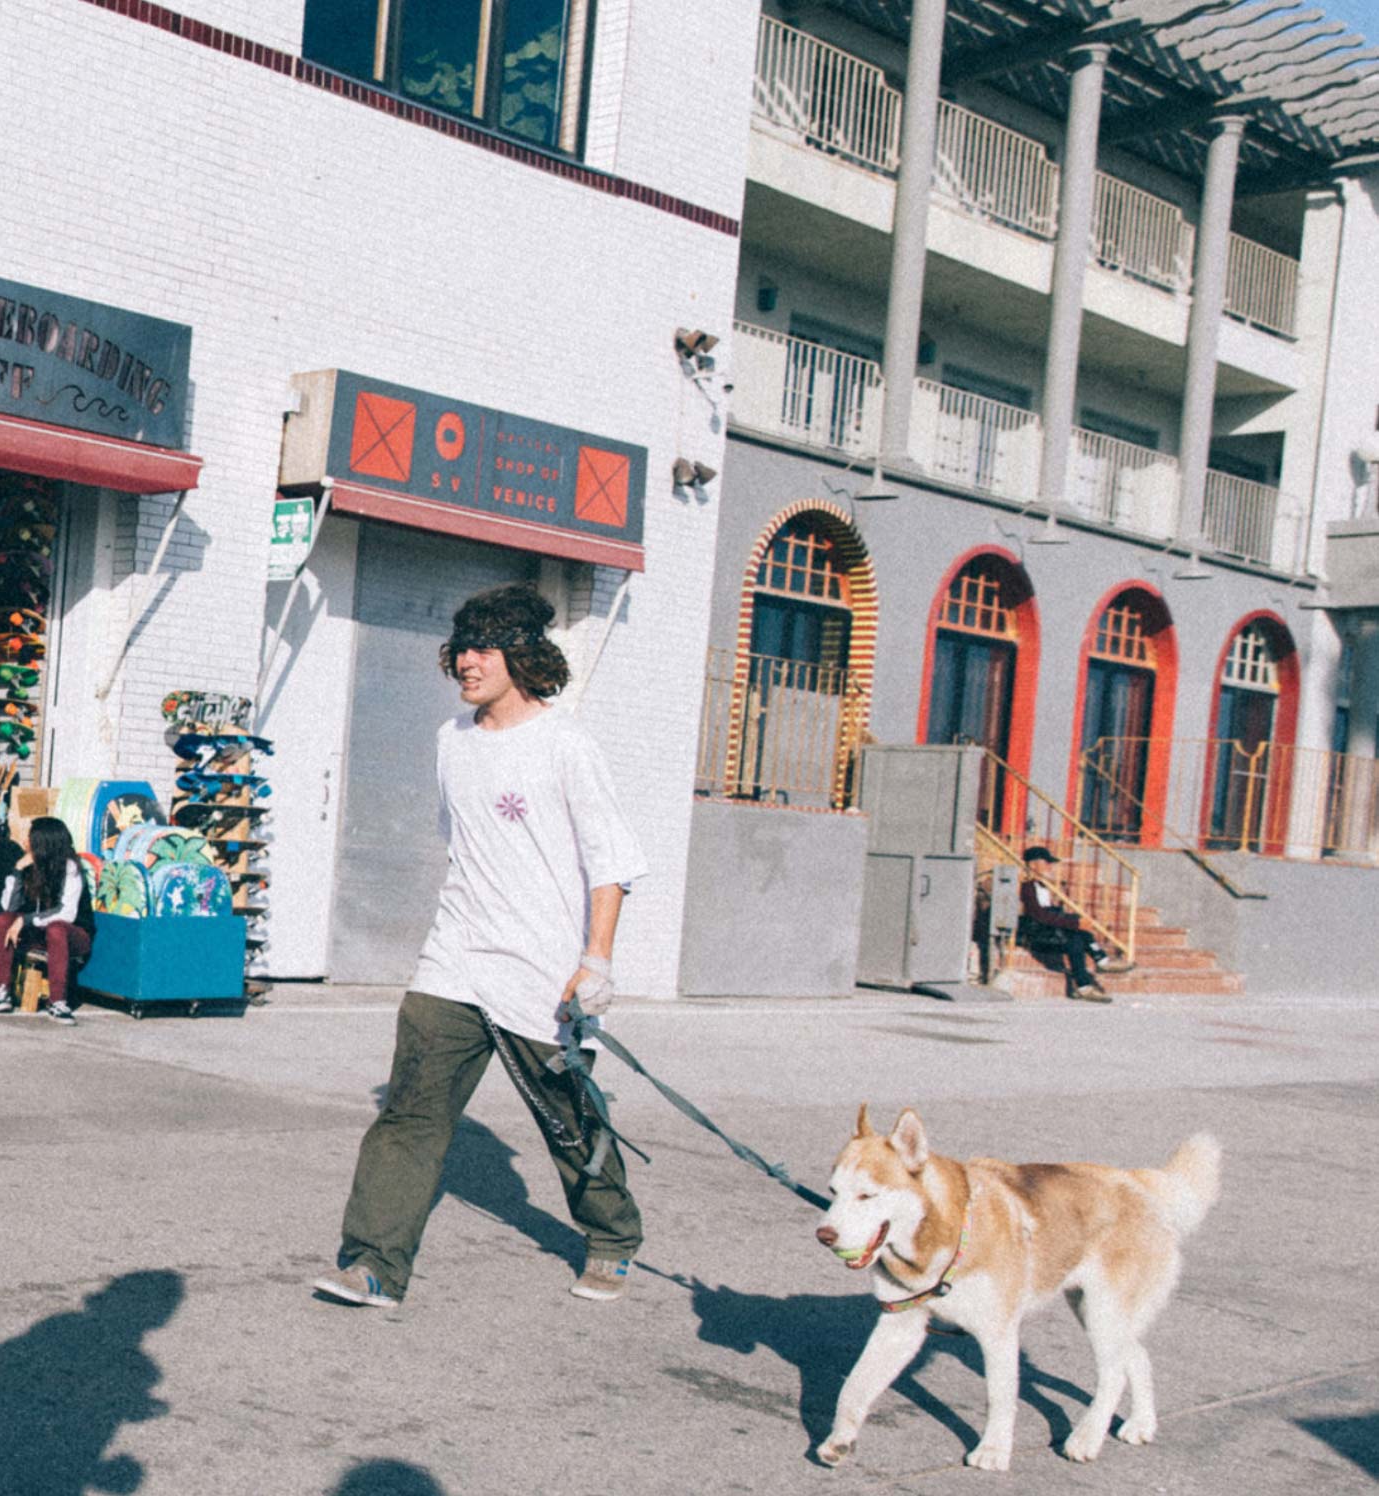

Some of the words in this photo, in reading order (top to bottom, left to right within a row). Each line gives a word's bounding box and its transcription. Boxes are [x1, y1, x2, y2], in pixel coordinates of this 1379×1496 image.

[494, 455, 536, 476] SHOP
[540, 466, 559, 481] OF
[493, 485, 557, 513] VENICE
